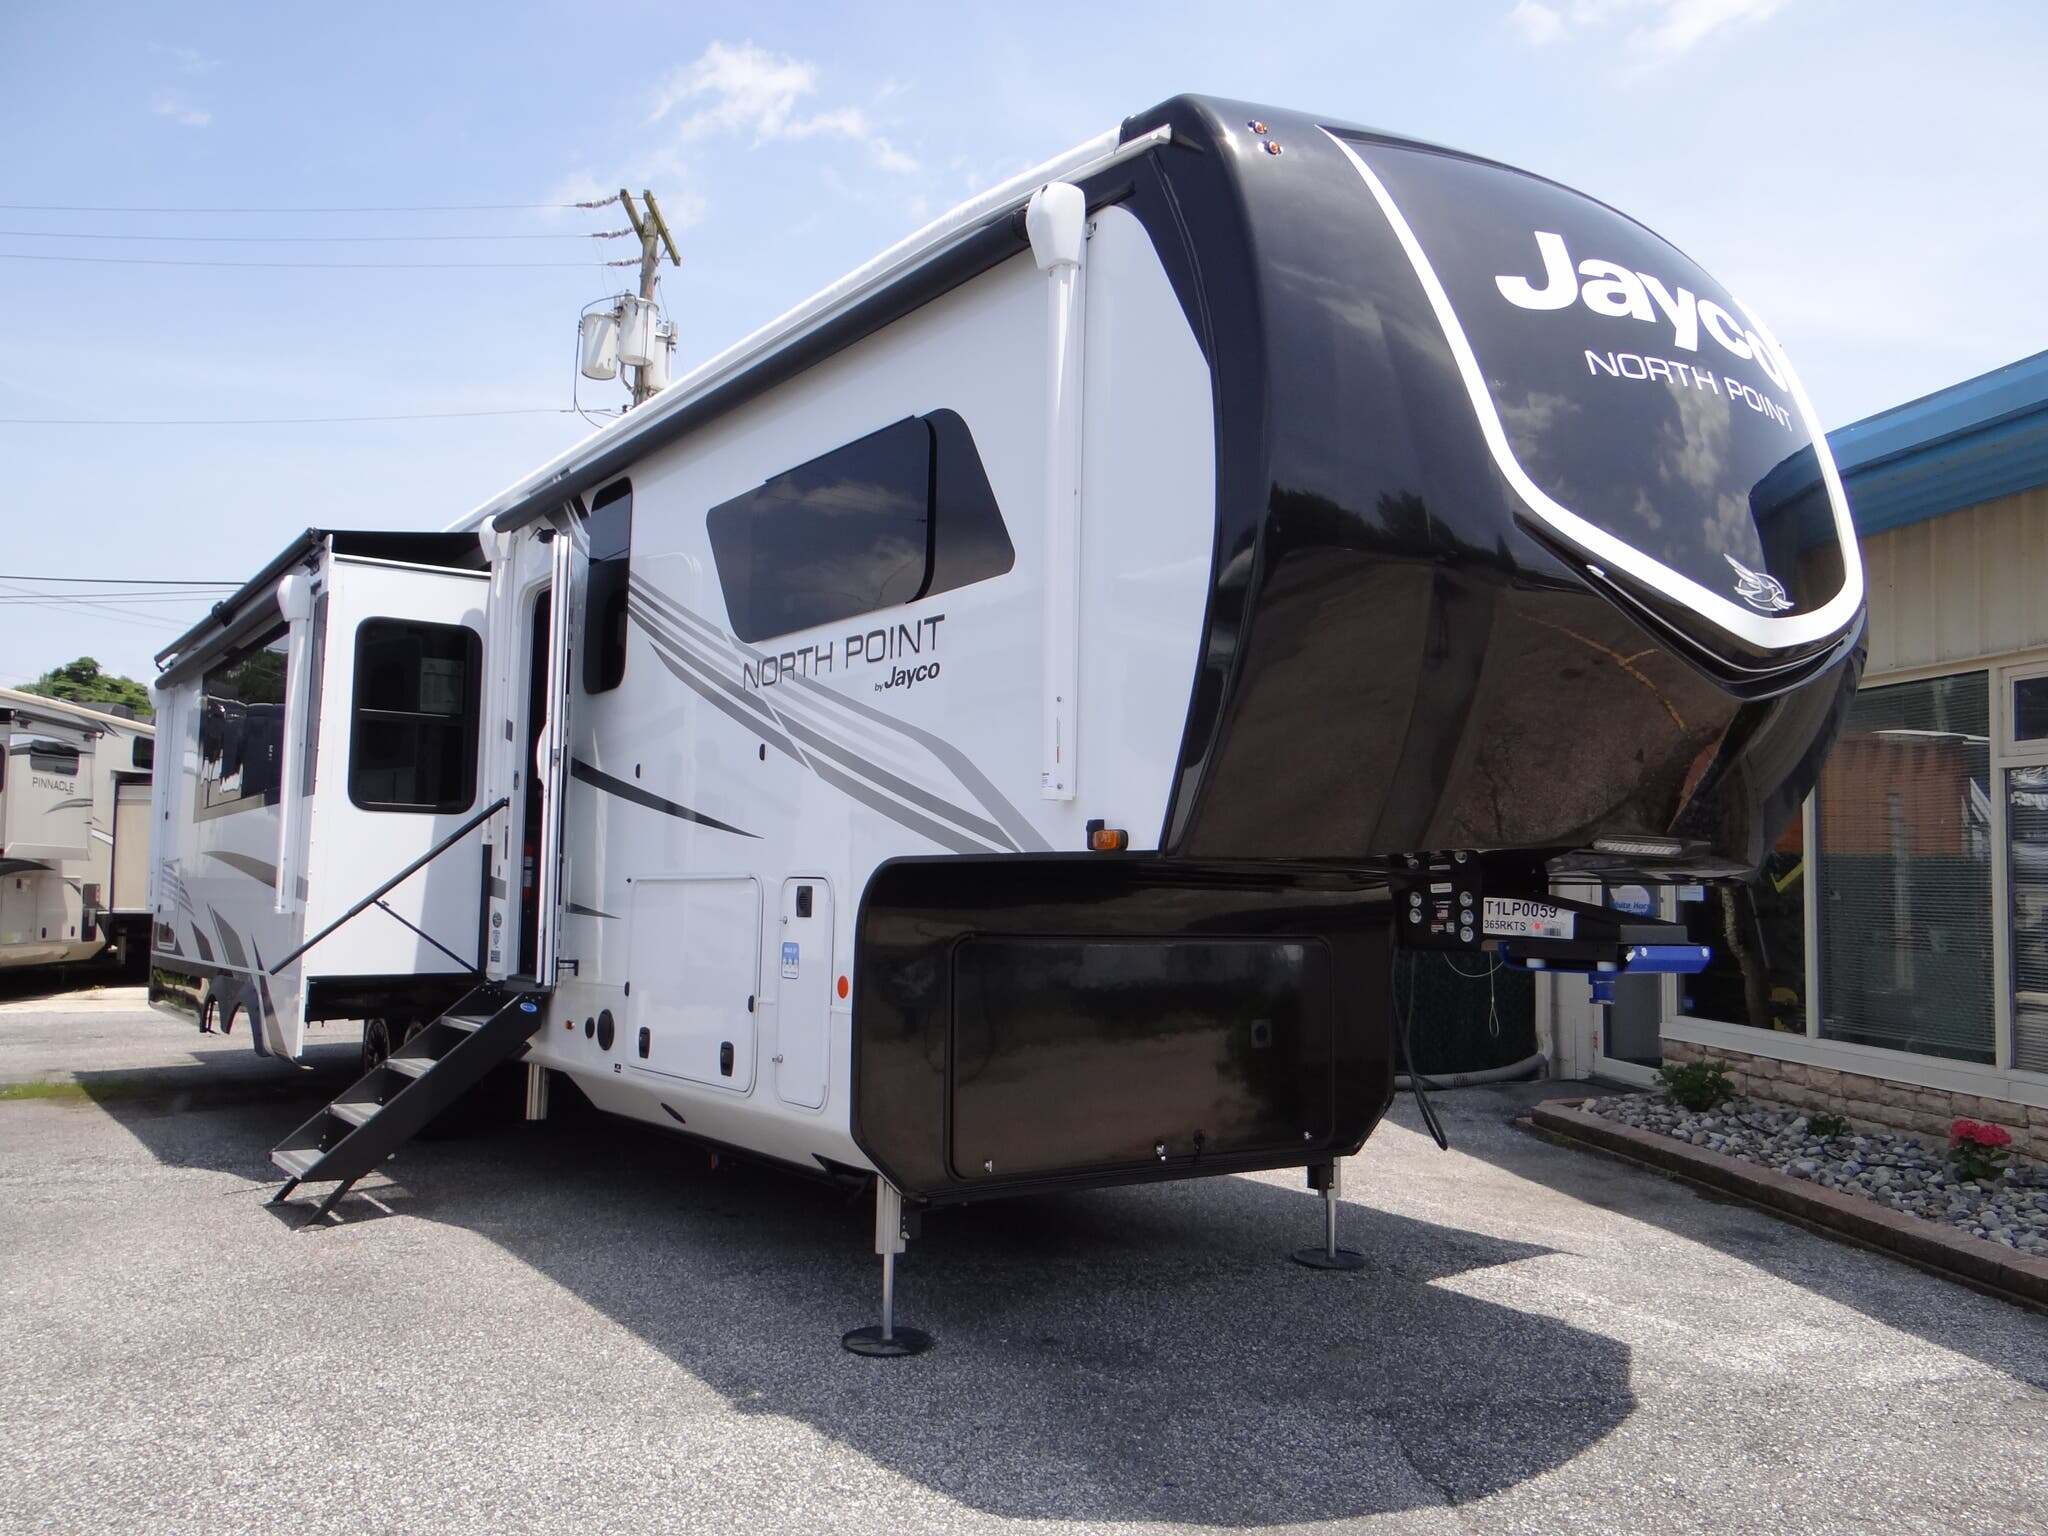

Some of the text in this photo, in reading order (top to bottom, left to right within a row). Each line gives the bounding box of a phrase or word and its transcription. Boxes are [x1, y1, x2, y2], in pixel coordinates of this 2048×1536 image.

[1495, 230, 1790, 393] Jayco
[1585, 350, 1793, 432] NORTH POINT
[743, 613, 946, 691] NORTH POINT
[874, 662, 941, 693] by Jayco
[32, 776, 75, 793] PINNACLE
[1485, 900, 1558, 918] T1LP0059
[1484, 919, 1527, 932] 365RKTS
